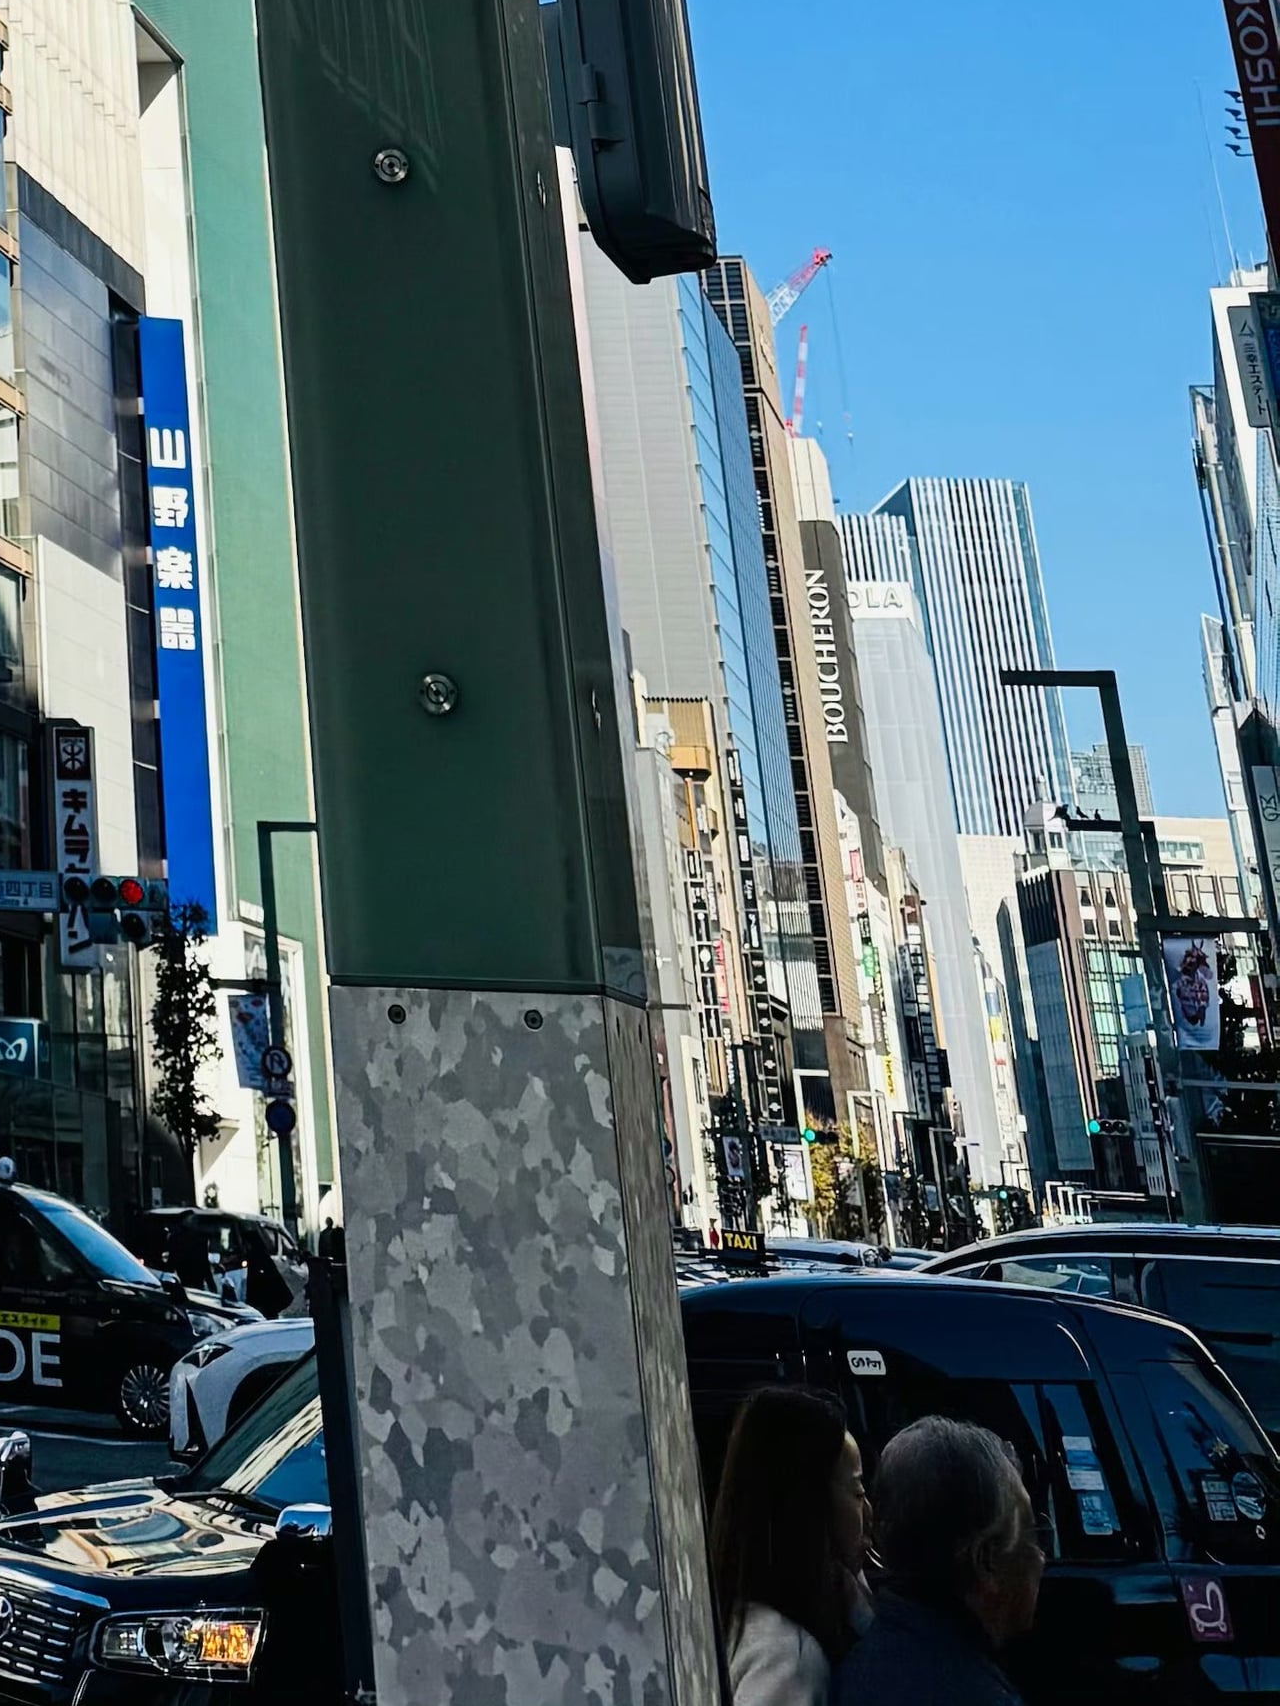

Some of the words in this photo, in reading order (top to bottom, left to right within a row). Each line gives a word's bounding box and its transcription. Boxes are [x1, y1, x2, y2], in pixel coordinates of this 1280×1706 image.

[149, 425, 196, 651] 山野楽器
[848, 587, 903, 608] OLA
[805, 568, 849, 744] BOUCHERON
[724, 1232, 758, 1250] TAXI
